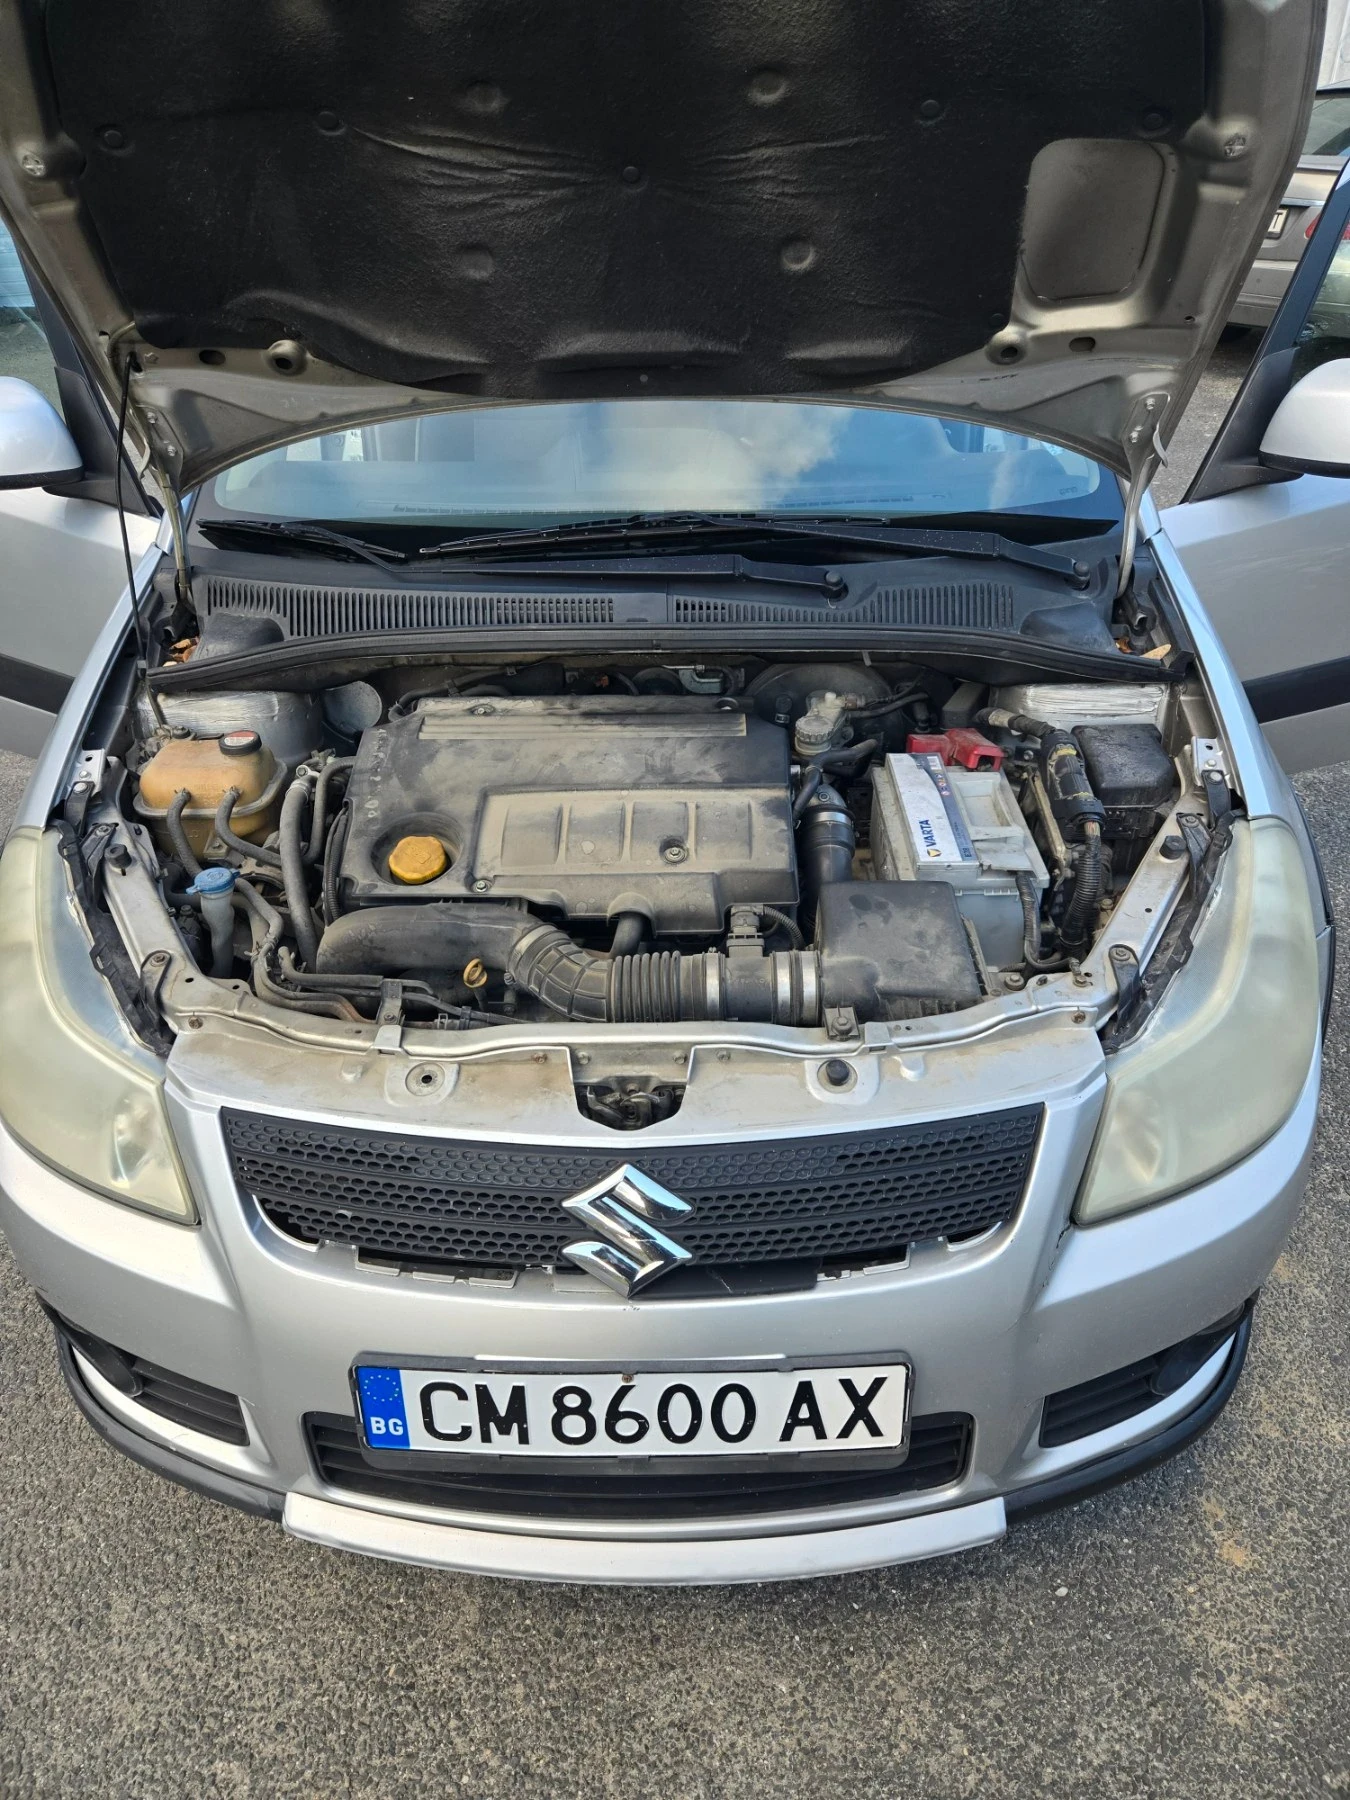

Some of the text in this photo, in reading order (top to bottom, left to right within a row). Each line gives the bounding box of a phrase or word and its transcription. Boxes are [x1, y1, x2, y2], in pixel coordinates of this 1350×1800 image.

[919, 819, 935, 847] VARTA
[419, 1376, 888, 1445] CM 8600 AX
[371, 1417, 405, 1437] BG
